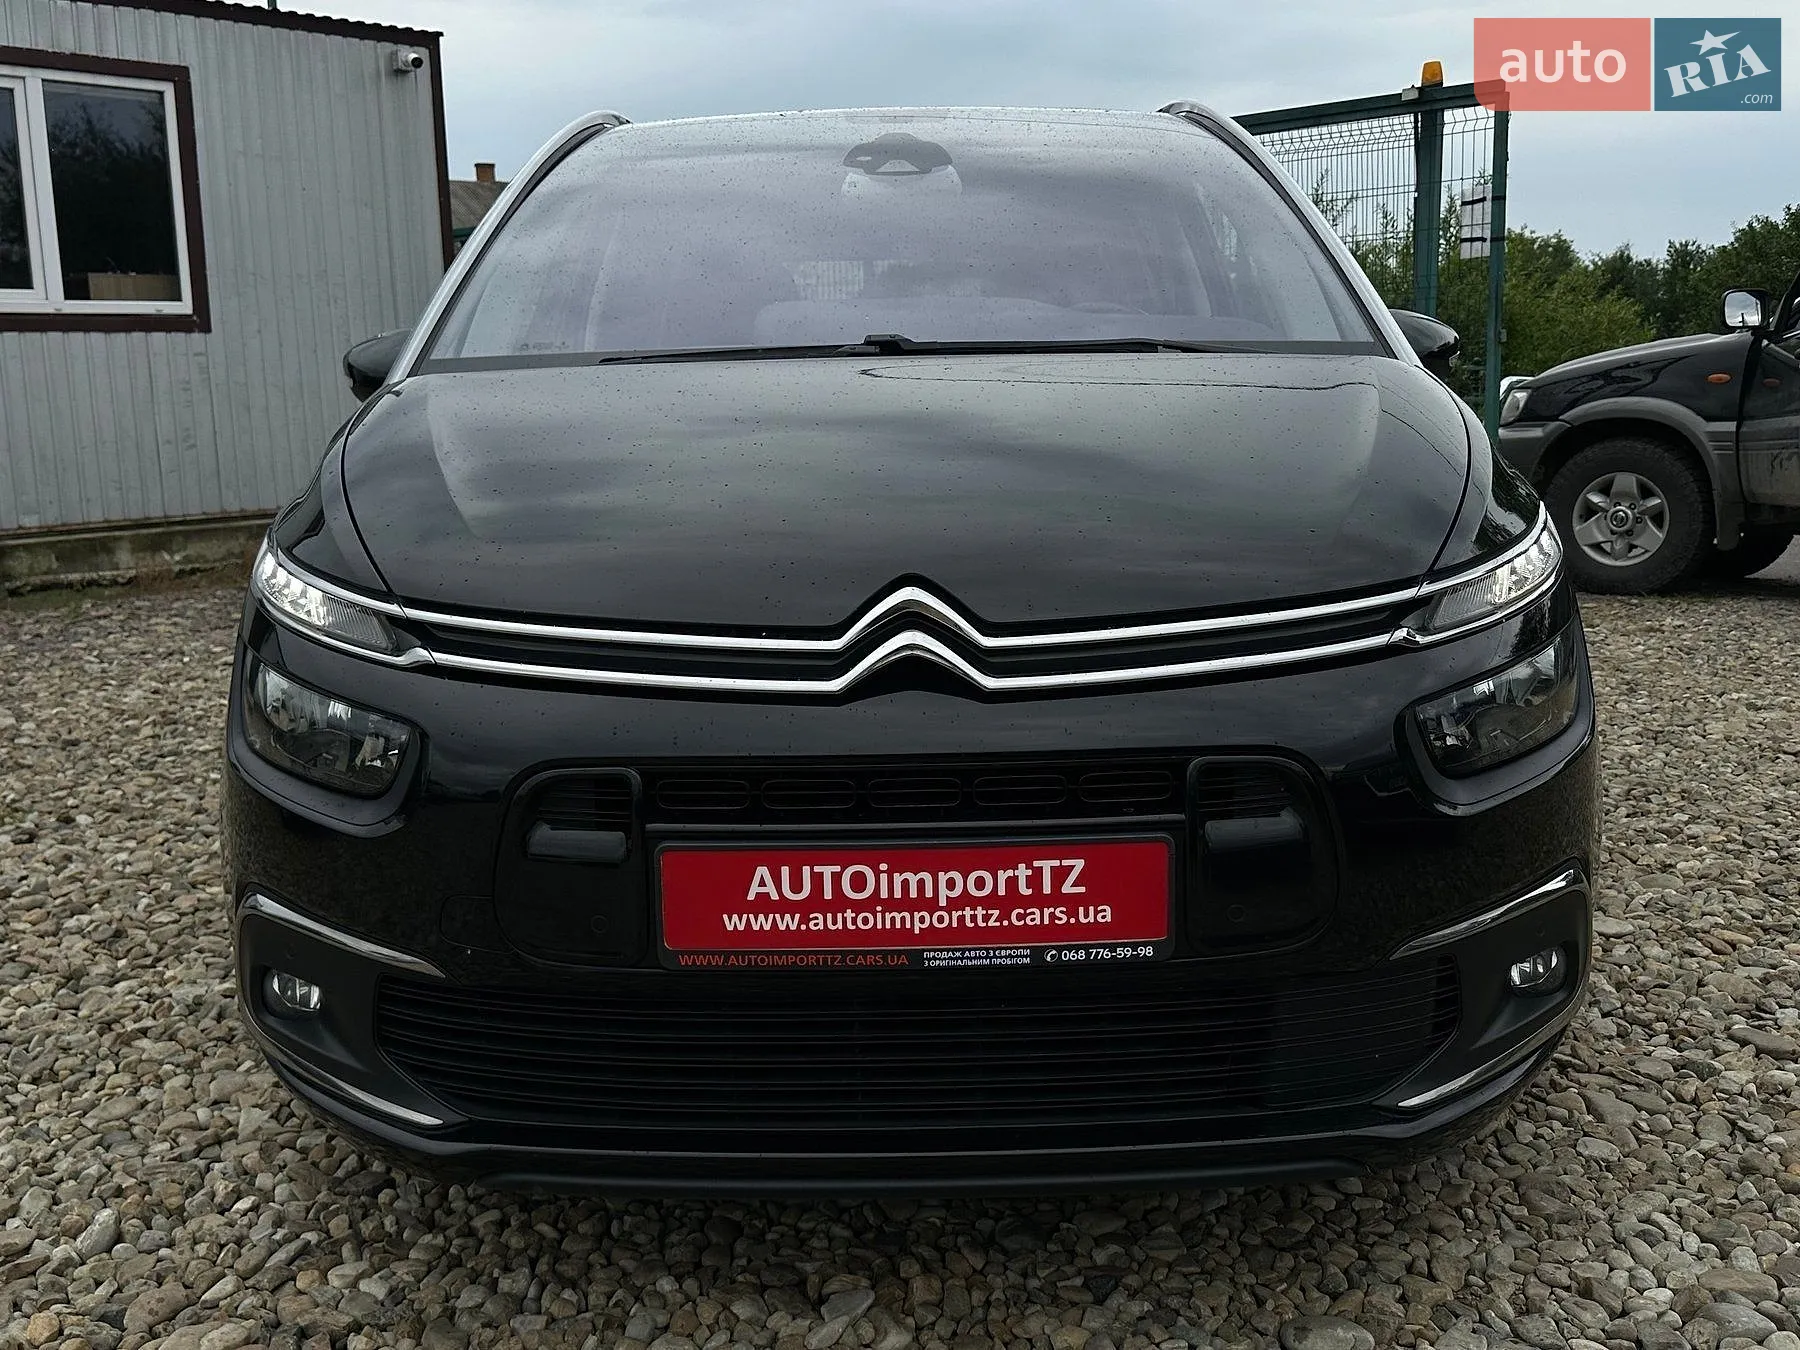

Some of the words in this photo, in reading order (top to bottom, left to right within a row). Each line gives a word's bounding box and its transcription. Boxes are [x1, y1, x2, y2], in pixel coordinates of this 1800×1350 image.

[746, 859, 1086, 906] AUTOimportTZ
[722, 905, 1112, 934] www.autoimporttz.cars.ua
[678, 954, 909, 966] WWW.AUTOIMPORTTZ.CARS.UA
[923, 950, 963, 959] ПРОДАЖ
[964, 950, 987, 958] АВТО
[996, 949, 1031, 957] ЄВРОПИ
[1061, 949, 1086, 961] 068
[1089, 946, 1154, 960] 776-59-98
[929, 958, 991, 967] ОРИГІНАЛЬНИМ
[991, 957, 1031, 966] ПРОБІГОМ
